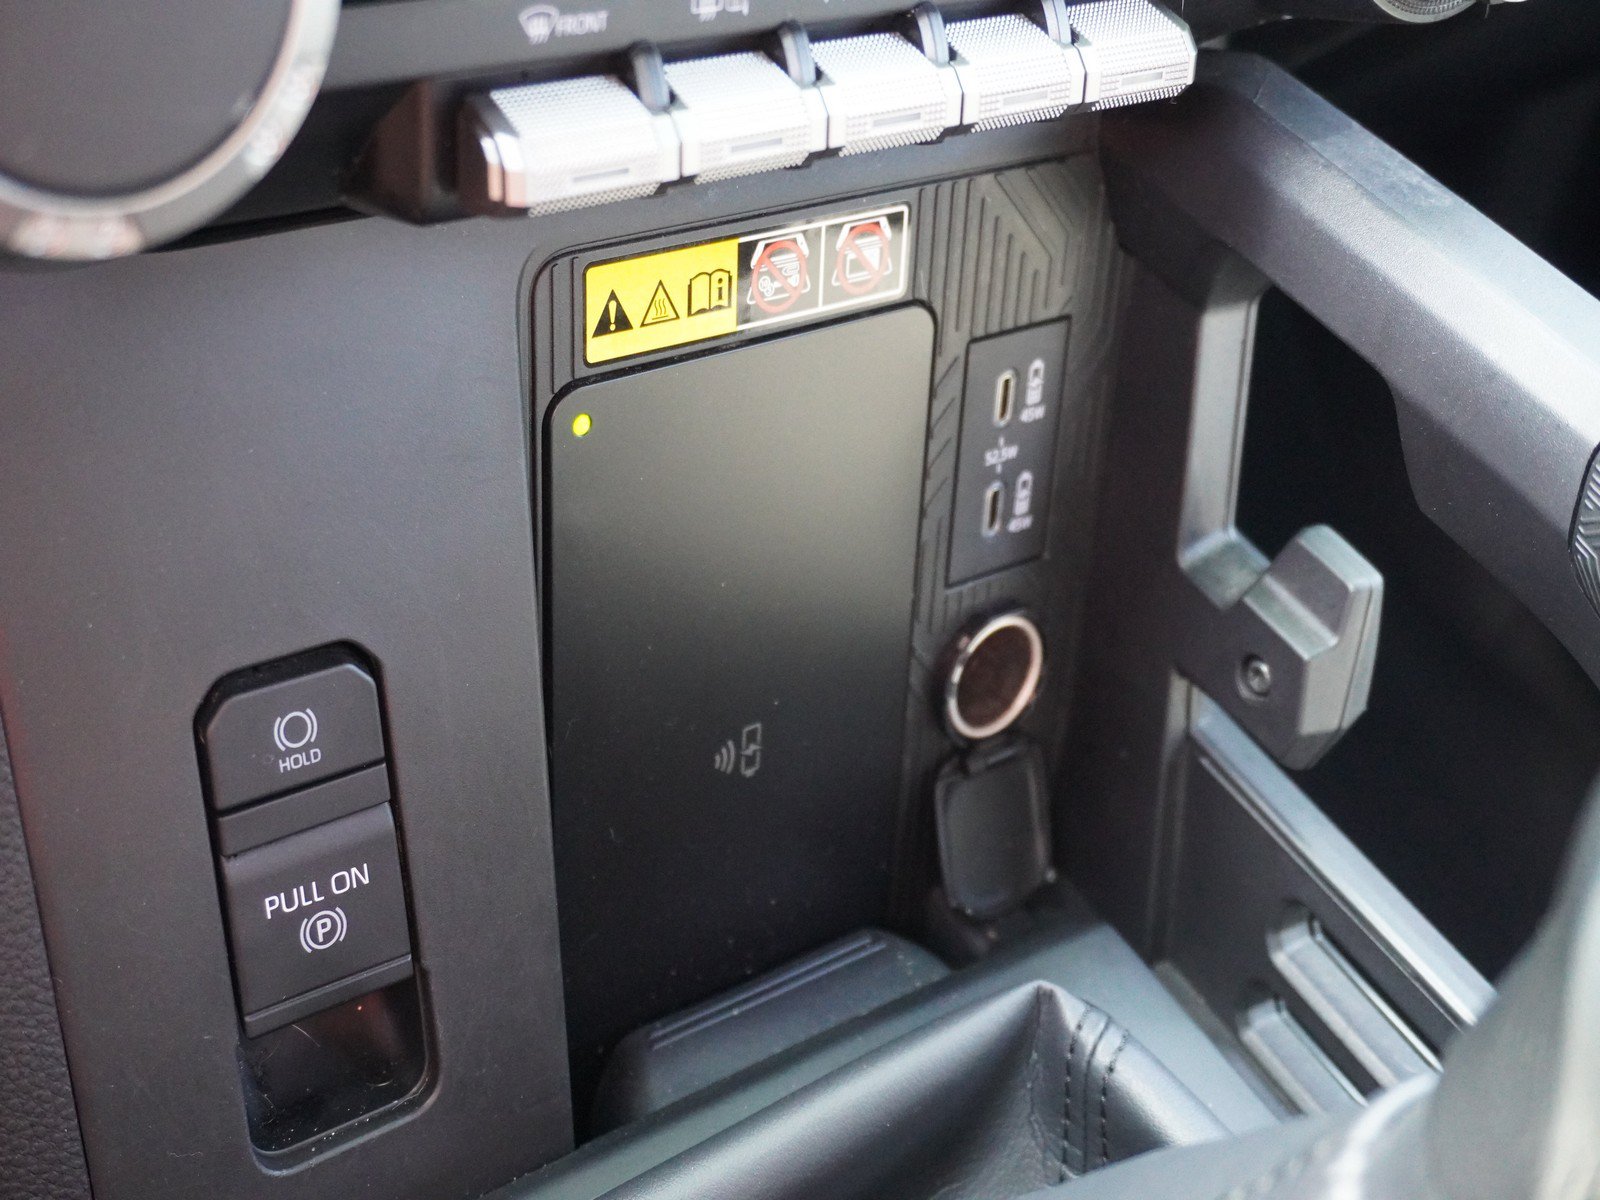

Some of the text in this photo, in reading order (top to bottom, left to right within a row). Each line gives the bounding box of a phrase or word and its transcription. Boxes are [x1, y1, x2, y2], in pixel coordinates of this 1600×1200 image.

[555, 10, 609, 37] FRONT
[278, 748, 321, 773] HOLD
[264, 863, 370, 919] PULL ON
